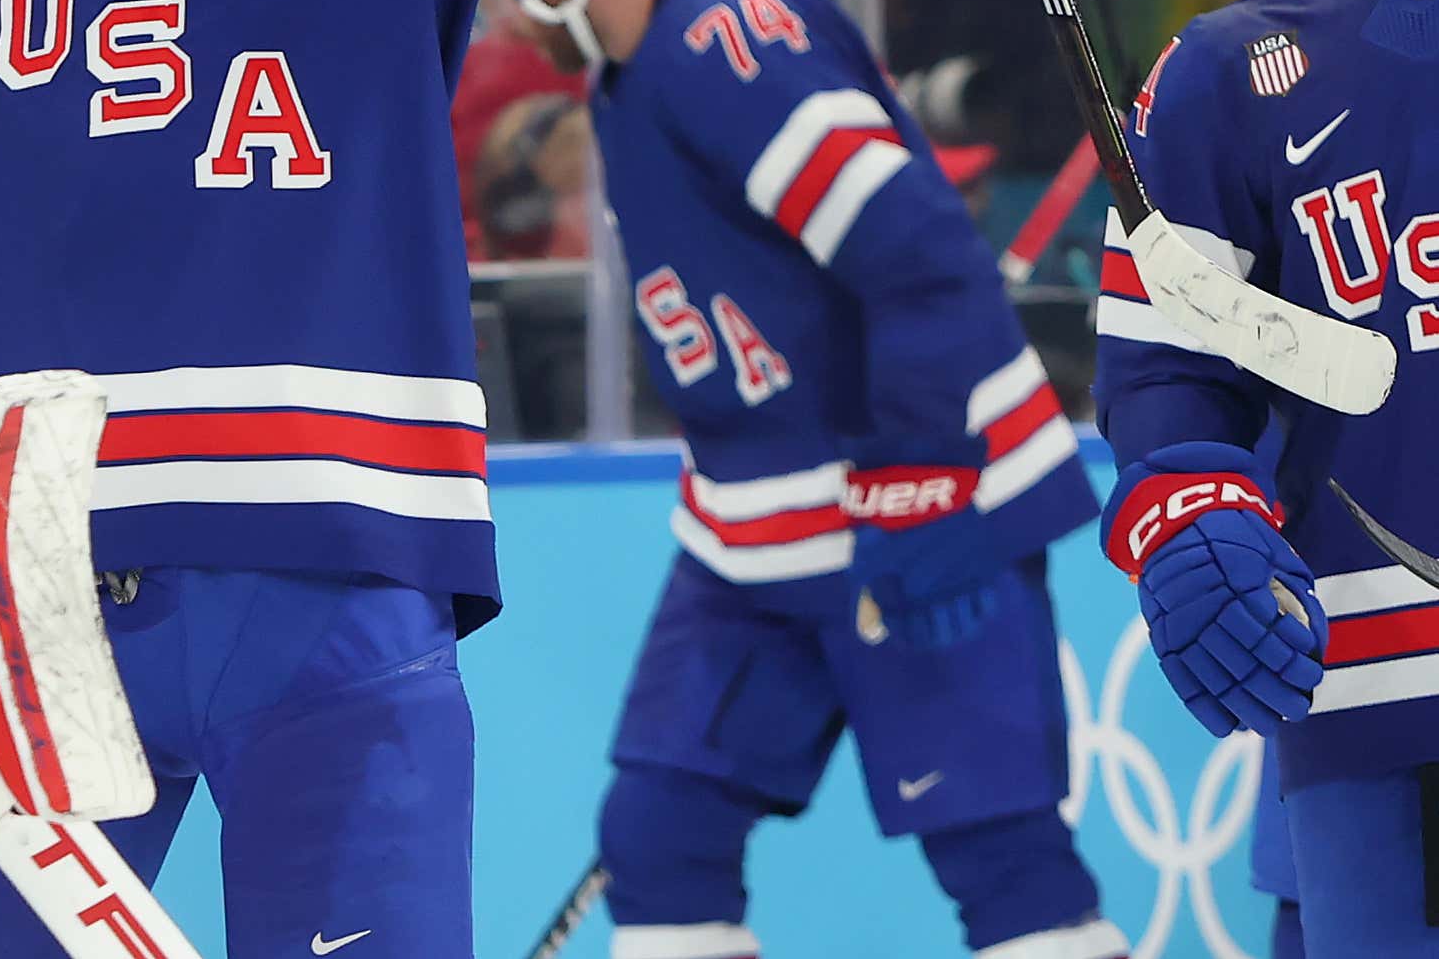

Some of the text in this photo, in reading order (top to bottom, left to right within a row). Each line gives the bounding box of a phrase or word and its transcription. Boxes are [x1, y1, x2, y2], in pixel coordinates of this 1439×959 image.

[1253, 33, 1291, 56] USA
[841, 475, 957, 518] UER
[1128, 482, 1283, 561] CCM
